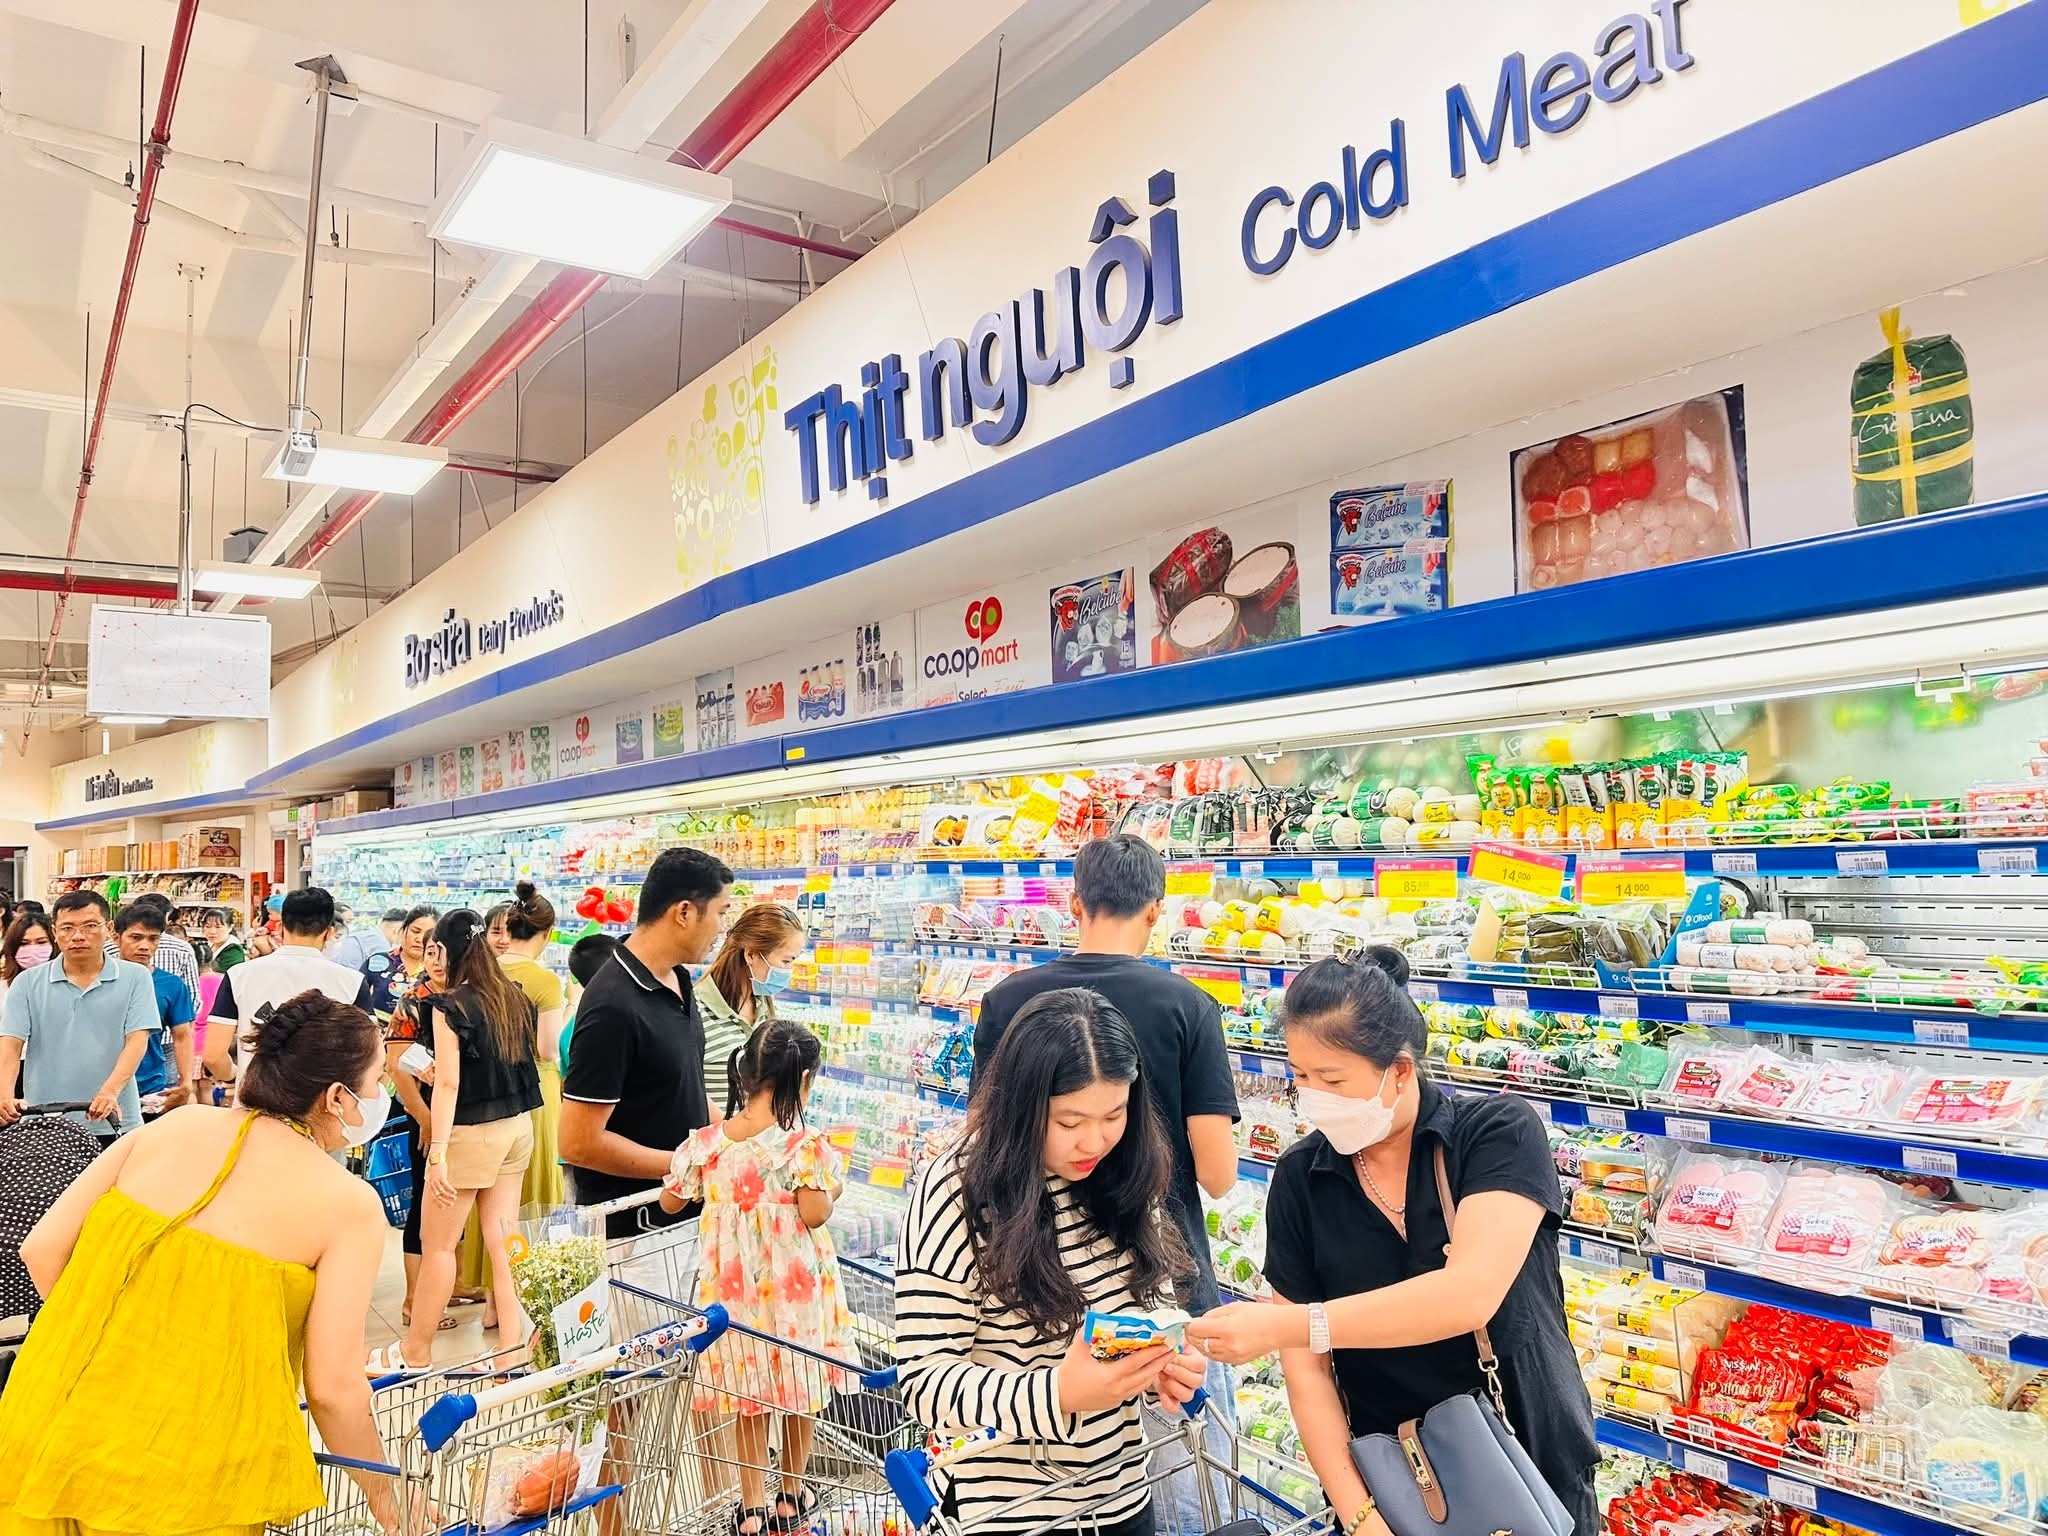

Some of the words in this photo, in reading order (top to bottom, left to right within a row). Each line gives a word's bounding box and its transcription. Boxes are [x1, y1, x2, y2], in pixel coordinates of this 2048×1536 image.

[1241, 117, 1409, 276] Cold
[1446, 0, 1695, 180] Meat
[784, 353, 913, 504] Thịt
[919, 169, 1183, 447] nguội
[478, 619, 507, 655] Dairy
[509, 589, 565, 641] Products
